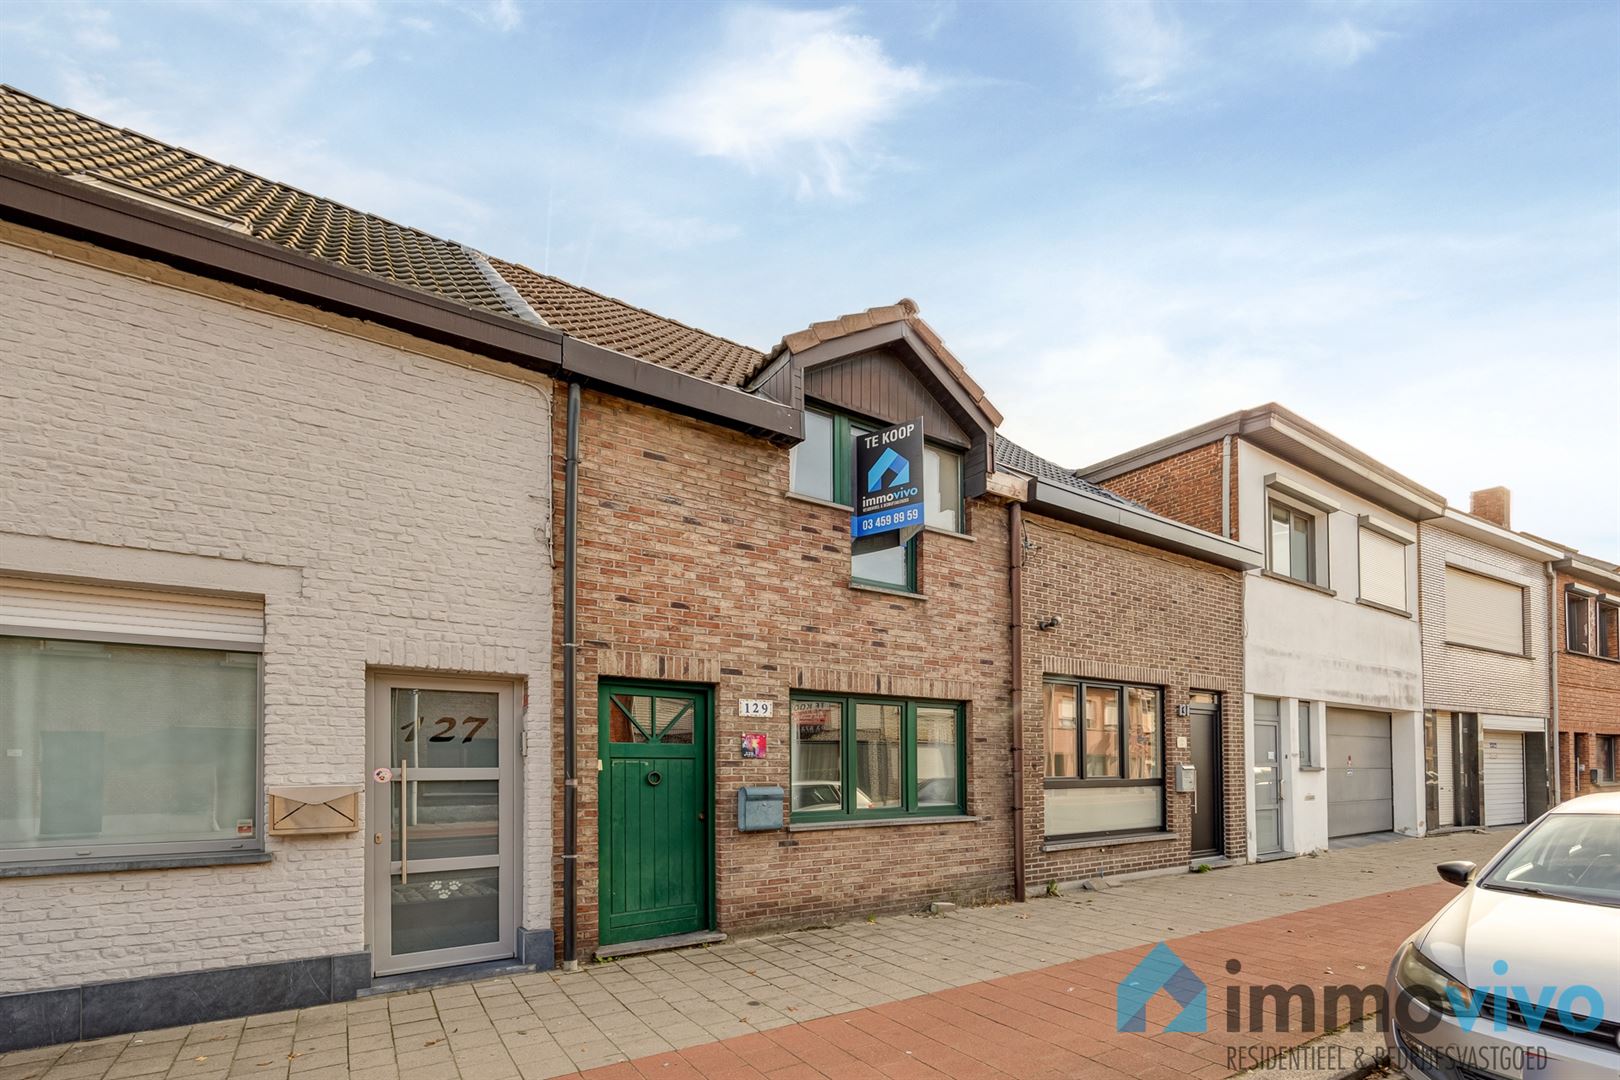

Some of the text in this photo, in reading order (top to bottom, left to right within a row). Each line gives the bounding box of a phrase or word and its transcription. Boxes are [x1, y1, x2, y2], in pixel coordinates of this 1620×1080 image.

[864, 423, 915, 449] TE KOOP
[862, 486, 918, 508] immovivo
[862, 508, 919, 531] 03 459 89 59
[745, 703, 768, 714] 129
[400, 716, 489, 744] 127
